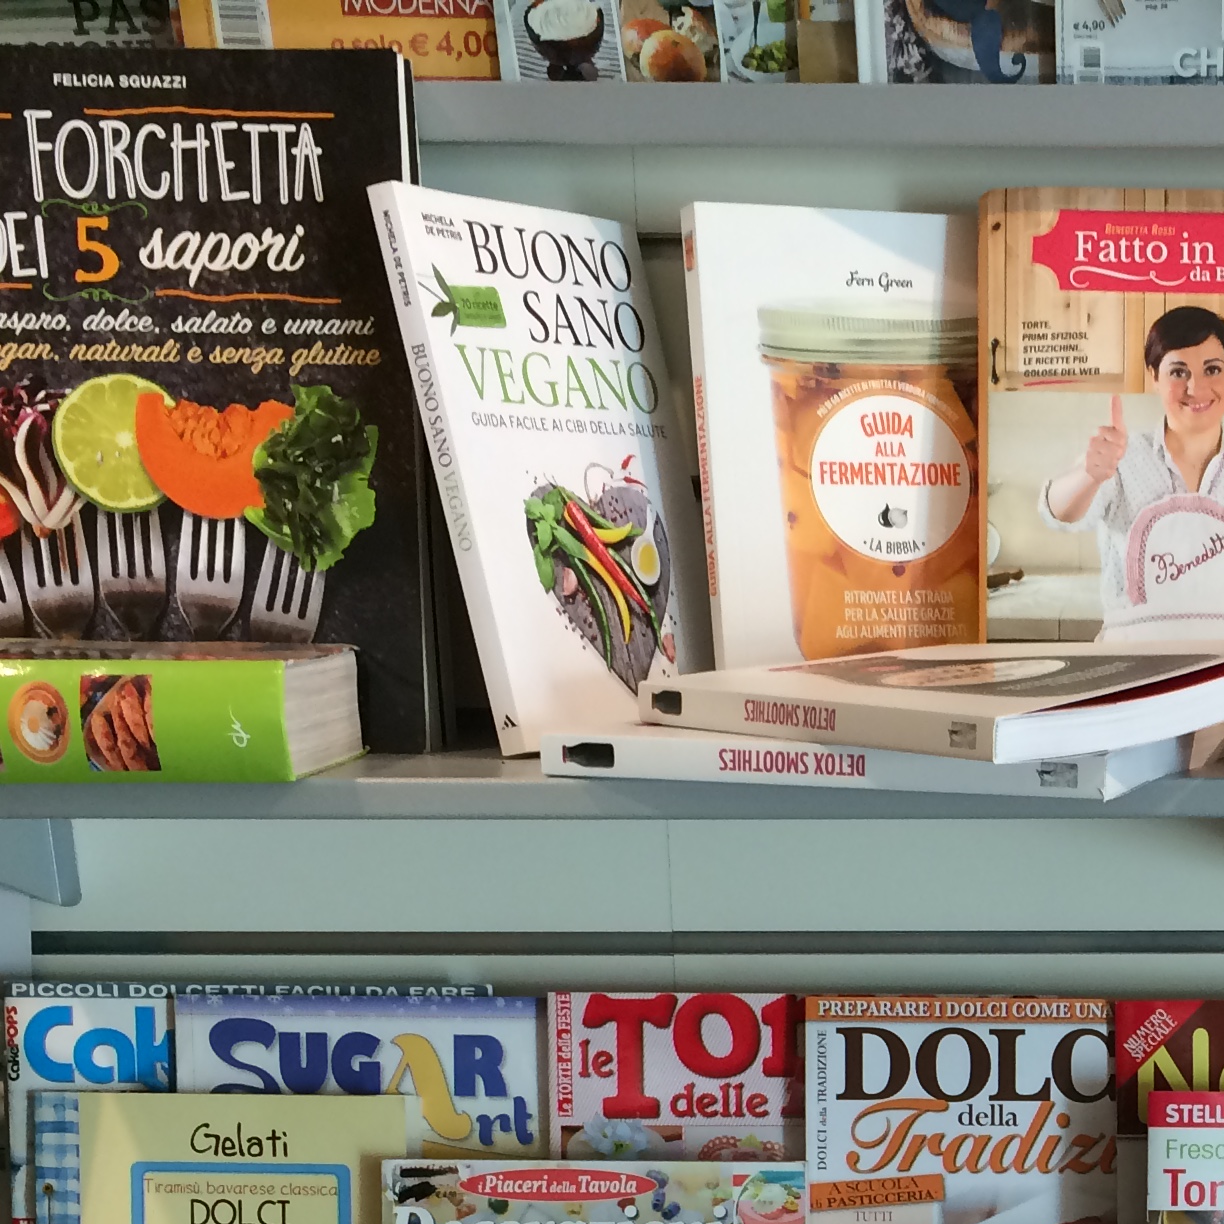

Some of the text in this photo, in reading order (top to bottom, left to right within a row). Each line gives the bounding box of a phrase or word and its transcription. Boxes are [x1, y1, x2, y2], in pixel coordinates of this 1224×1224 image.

[52, 73, 188, 89] FELICIA SGUAZZI
[23, 108, 324, 203] FORCHETTA
[74, 216, 305, 288] 5 sapori
[463, 217, 632, 294] BUONO
[1074, 231, 1168, 264] Fatto
[1179, 232, 1216, 265] in
[845, 269, 913, 293] Fern Green
[1189, 266, 1211, 283] da
[171, 310, 374, 335] salato e umami
[522, 291, 645, 354] SANO
[69, 339, 381, 376] naturali e senza glutine
[454, 343, 658, 414] VEGANO
[471, 411, 668, 441] GUIDA FACILE AI CIBI DELLA SALUTE
[860, 411, 914, 439] GUIDA
[874, 441, 906, 459] ALLA
[819, 461, 962, 488] FERMENTAZIONE
[869, 538, 921, 555] LA BIBBIA
[719, 748, 866, 777] DETOX SMOOTHIES
[818, 1000, 1071, 1020] PREPARARE I DOLCI COME
[189, 1122, 288, 1158] Gelati
[485, 1175, 638, 1195] Piaceri della Tavola
